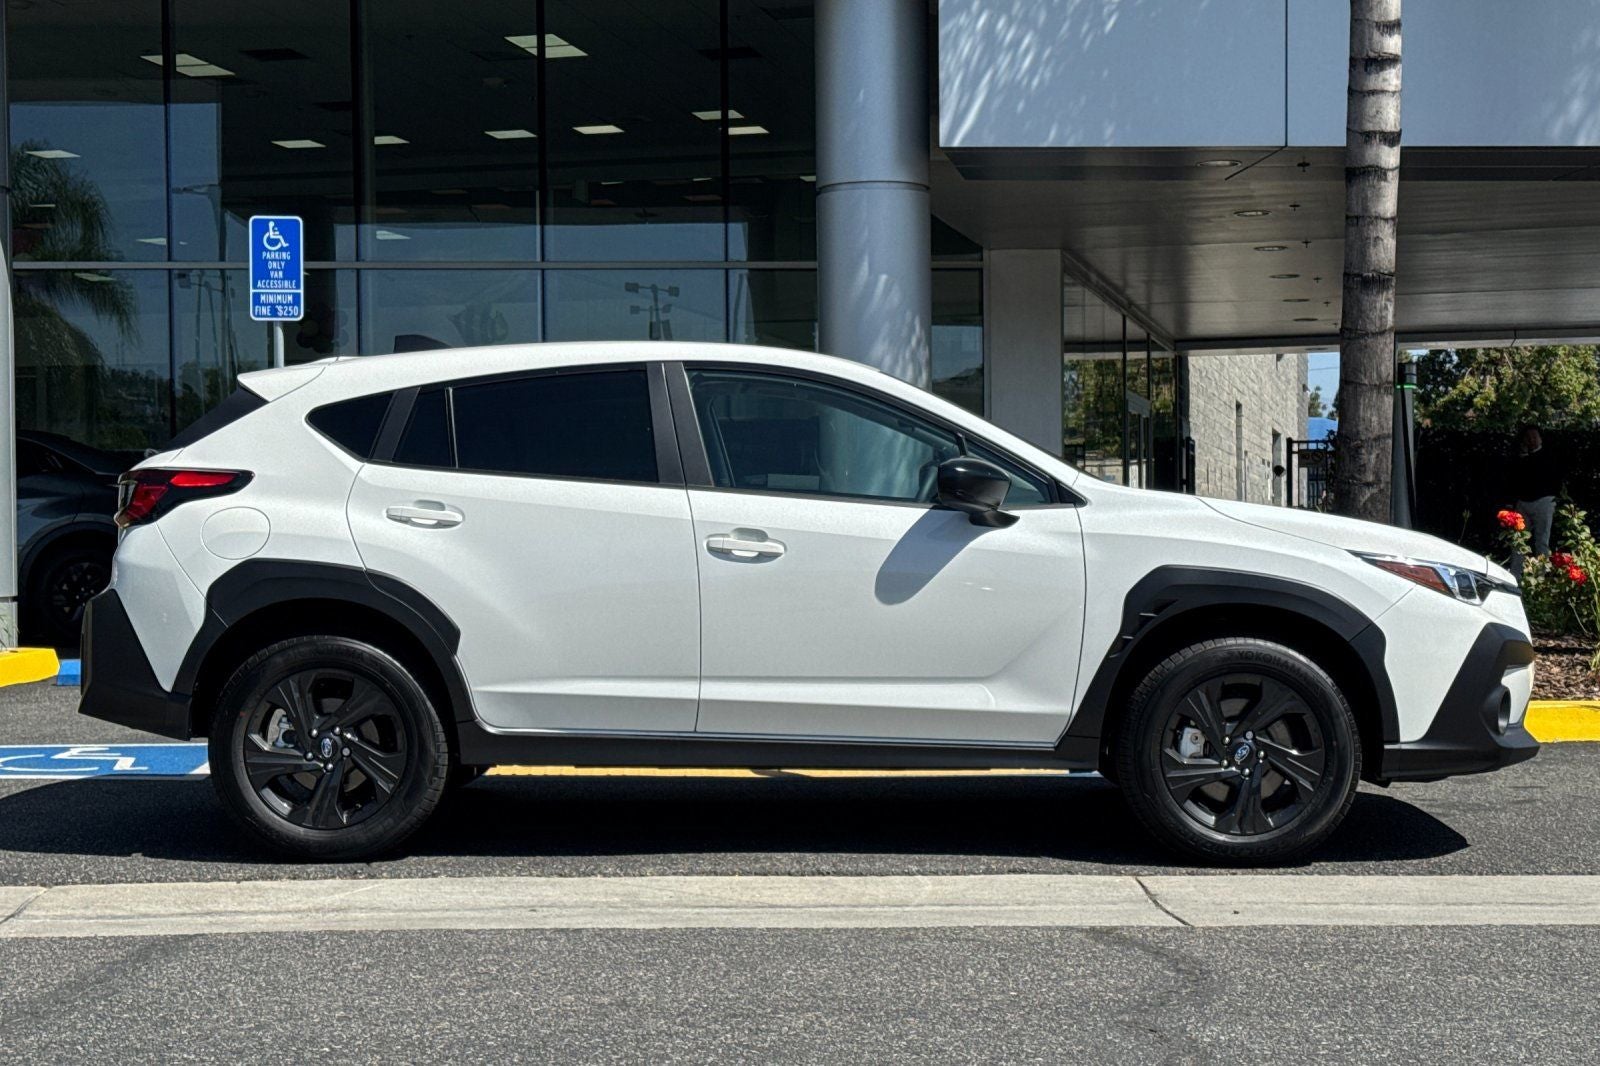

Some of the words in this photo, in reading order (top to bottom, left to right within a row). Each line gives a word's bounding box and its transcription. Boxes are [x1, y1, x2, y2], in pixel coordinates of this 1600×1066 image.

[262, 251, 291, 260] PARKING
[268, 261, 285, 269] ONLY
[269, 270, 283, 279] VAN
[257, 279, 296, 289] ACCESSIBLE
[260, 293, 293, 304] MINIMUM
[255, 305, 272, 316] FINE
[276, 305, 299, 317] $250
